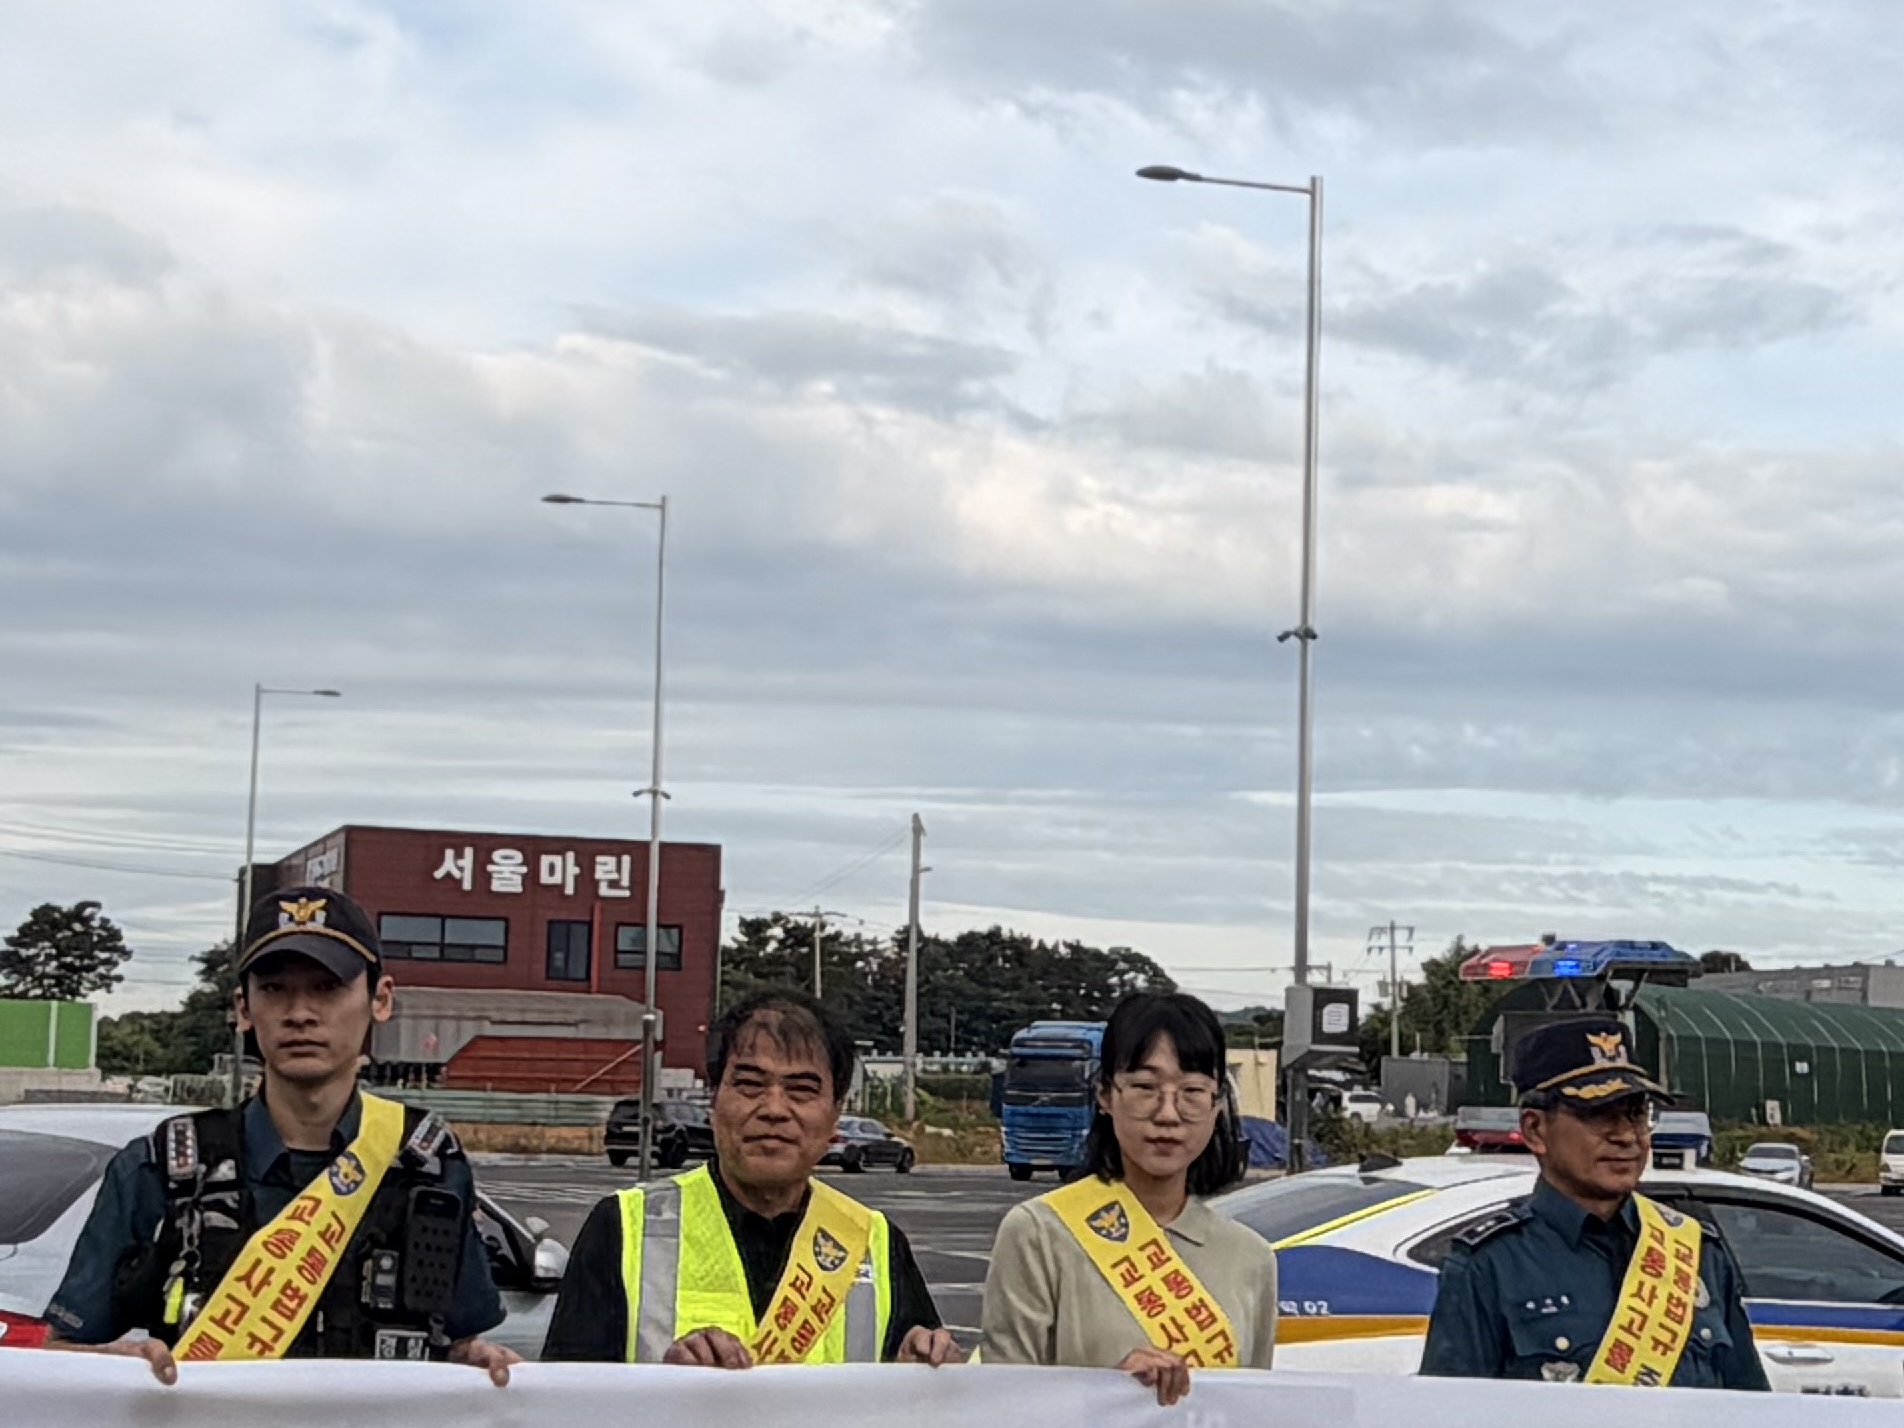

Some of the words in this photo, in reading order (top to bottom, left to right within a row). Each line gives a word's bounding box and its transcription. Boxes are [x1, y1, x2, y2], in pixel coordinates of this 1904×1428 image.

[432, 846, 633, 898] 서울마린
[246, 1210, 346, 1357] 교통법규
[1137, 1237, 1234, 1365] 교통법규
